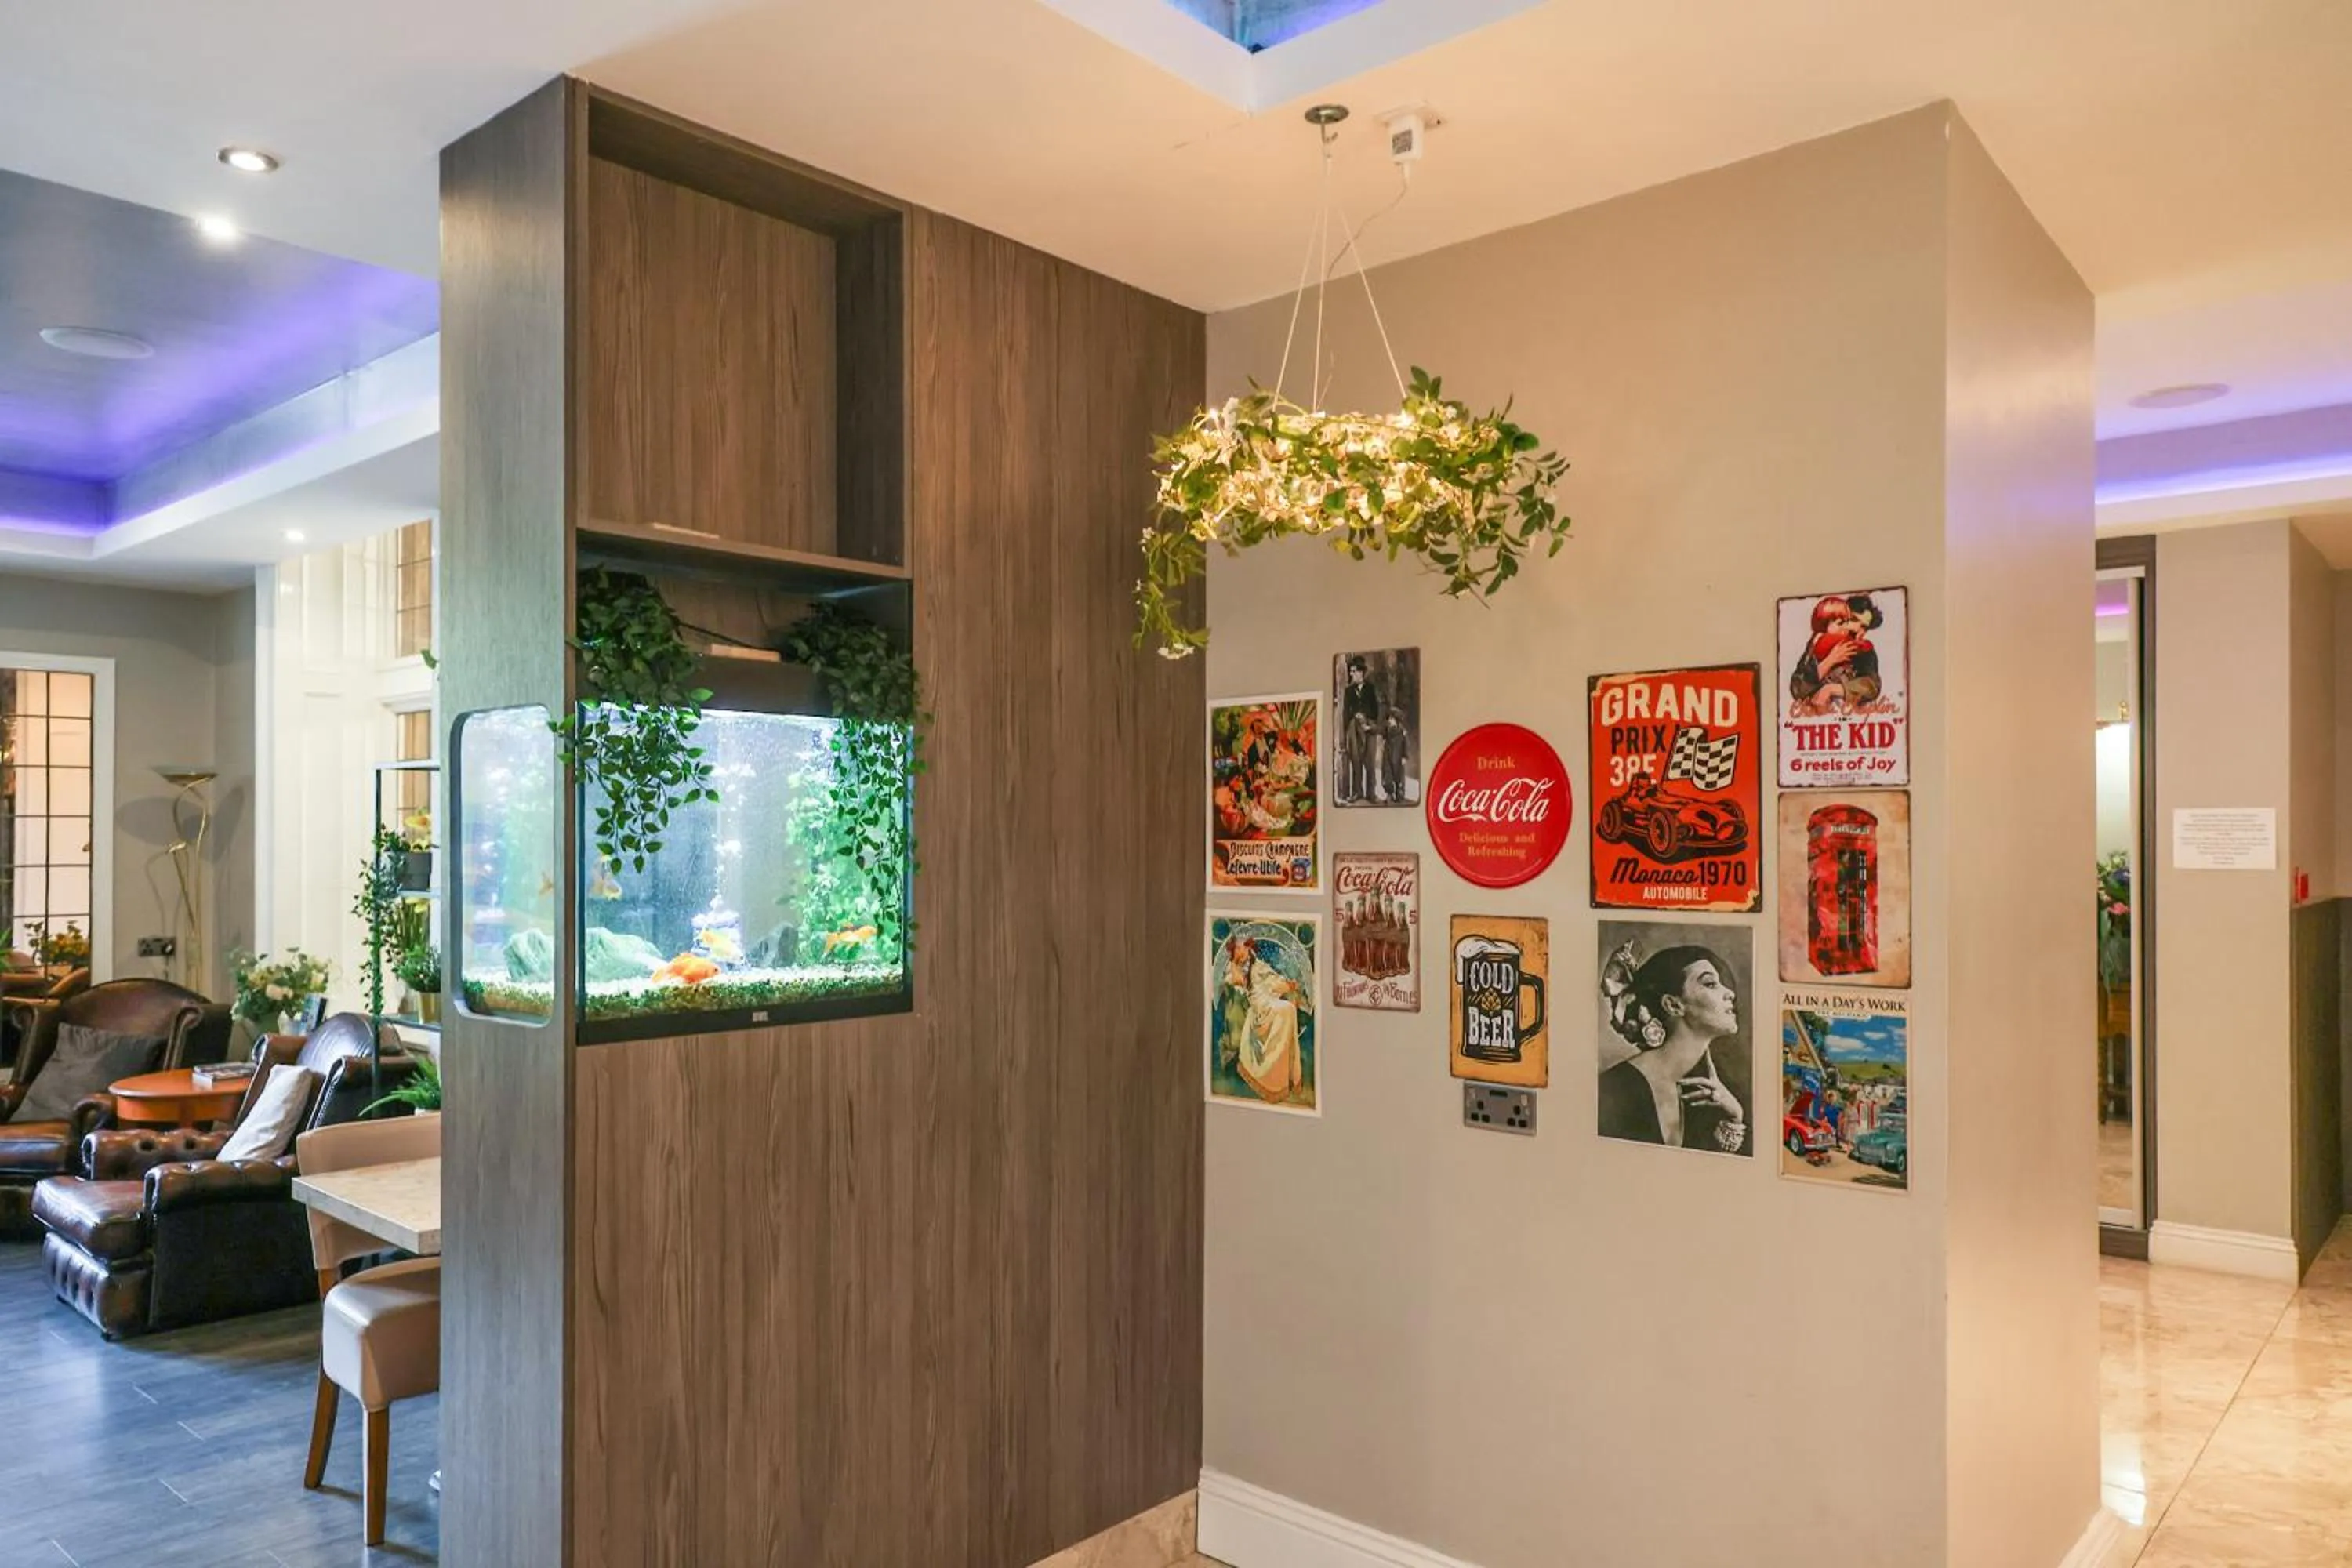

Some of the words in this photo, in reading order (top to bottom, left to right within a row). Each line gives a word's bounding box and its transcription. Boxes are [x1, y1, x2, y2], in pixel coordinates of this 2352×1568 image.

[1602, 683, 1738, 728] GRAND
[1611, 724, 1666, 754] PRIX
[1478, 756, 1515, 770] Drink
[1791, 758, 1802, 771] 6
[1805, 758, 1841, 771] reels
[1846, 756, 1866, 771] of
[1867, 757, 1896, 773] Joy
[1438, 777, 1555, 822] Coca-Cola
[1459, 832, 1508, 843] Delicious
[1515, 832, 1535, 843] and
[1468, 846, 1526, 860] Refreshing
[1336, 866, 1414, 895] Coca-Cola
[1610, 856, 1700, 885] Monaco
[1697, 860, 1747, 886] 1970
[1642, 887, 1708, 901] AUTOMOBILE
[1469, 960, 1515, 995] COLD
[1867, 999, 1906, 1012] WORK
[1468, 1006, 1515, 1050] BEER
